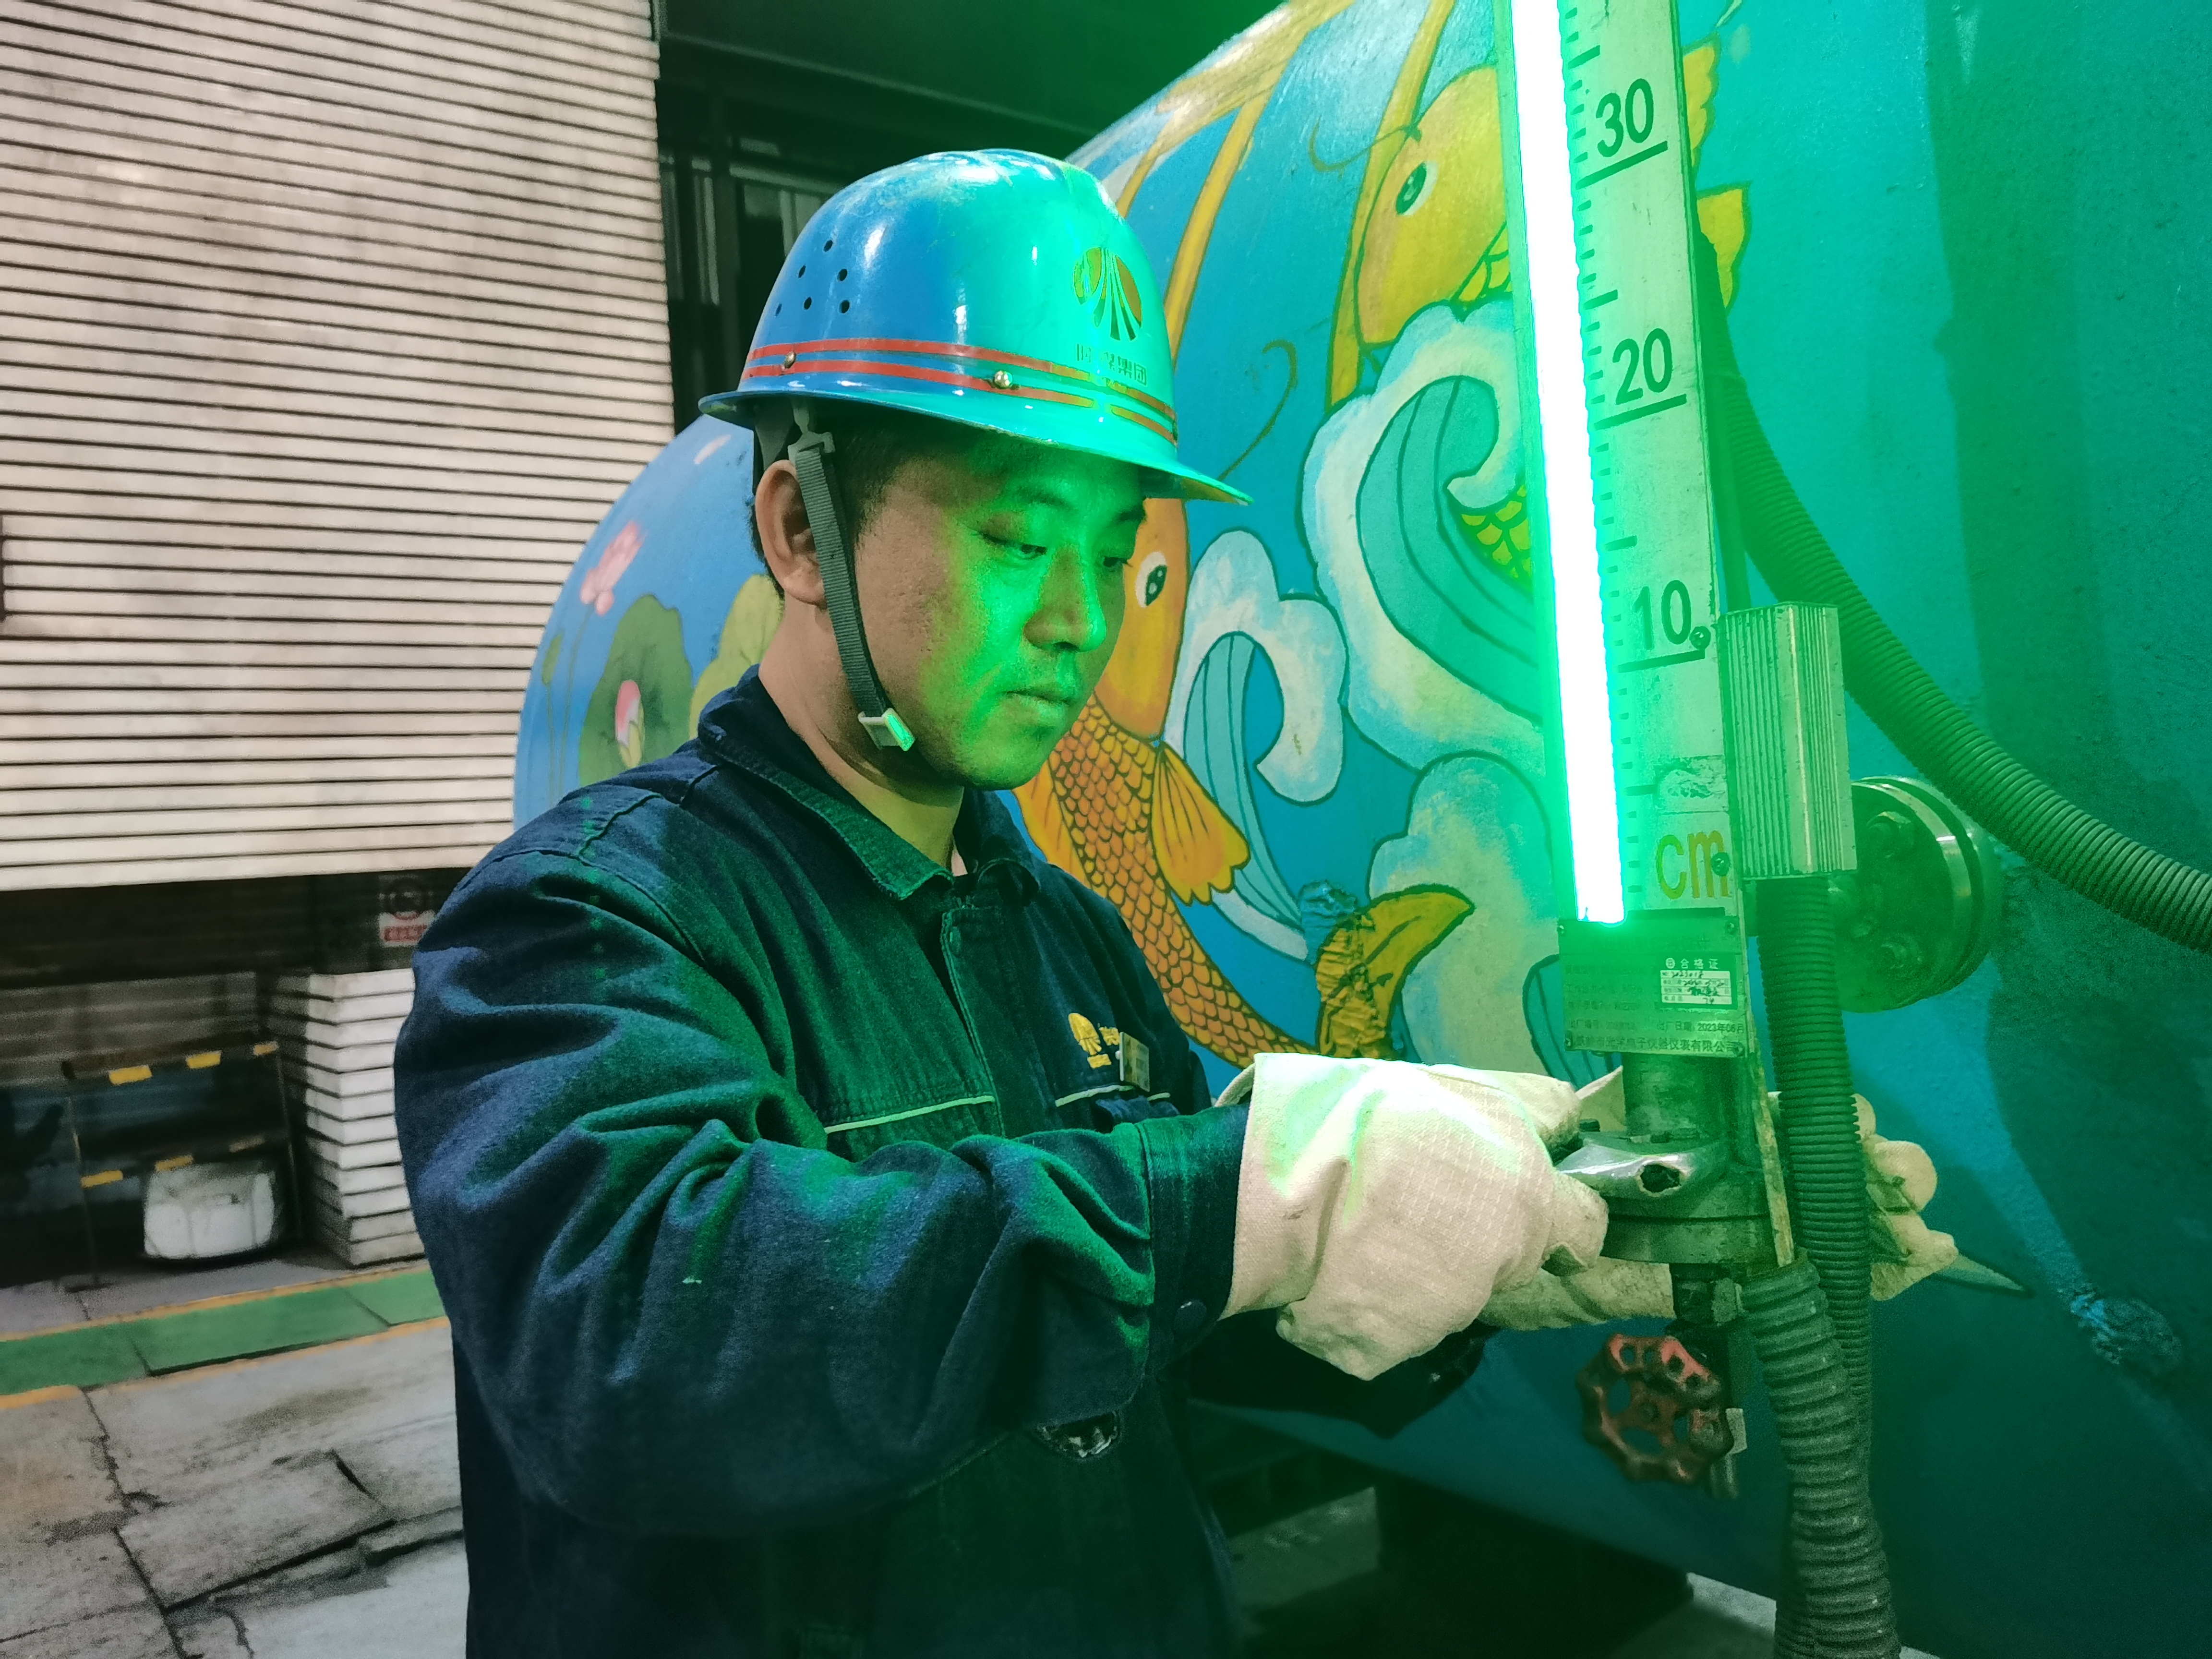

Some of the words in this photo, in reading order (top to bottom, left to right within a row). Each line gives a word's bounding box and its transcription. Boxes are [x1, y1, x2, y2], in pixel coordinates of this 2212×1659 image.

[1596, 78, 1654, 158] 30
[1612, 328, 1672, 405] 20
[1633, 579, 1692, 651] 10
[1655, 830, 1729, 900] cm
[1681, 958, 1719, 970] 合格证
